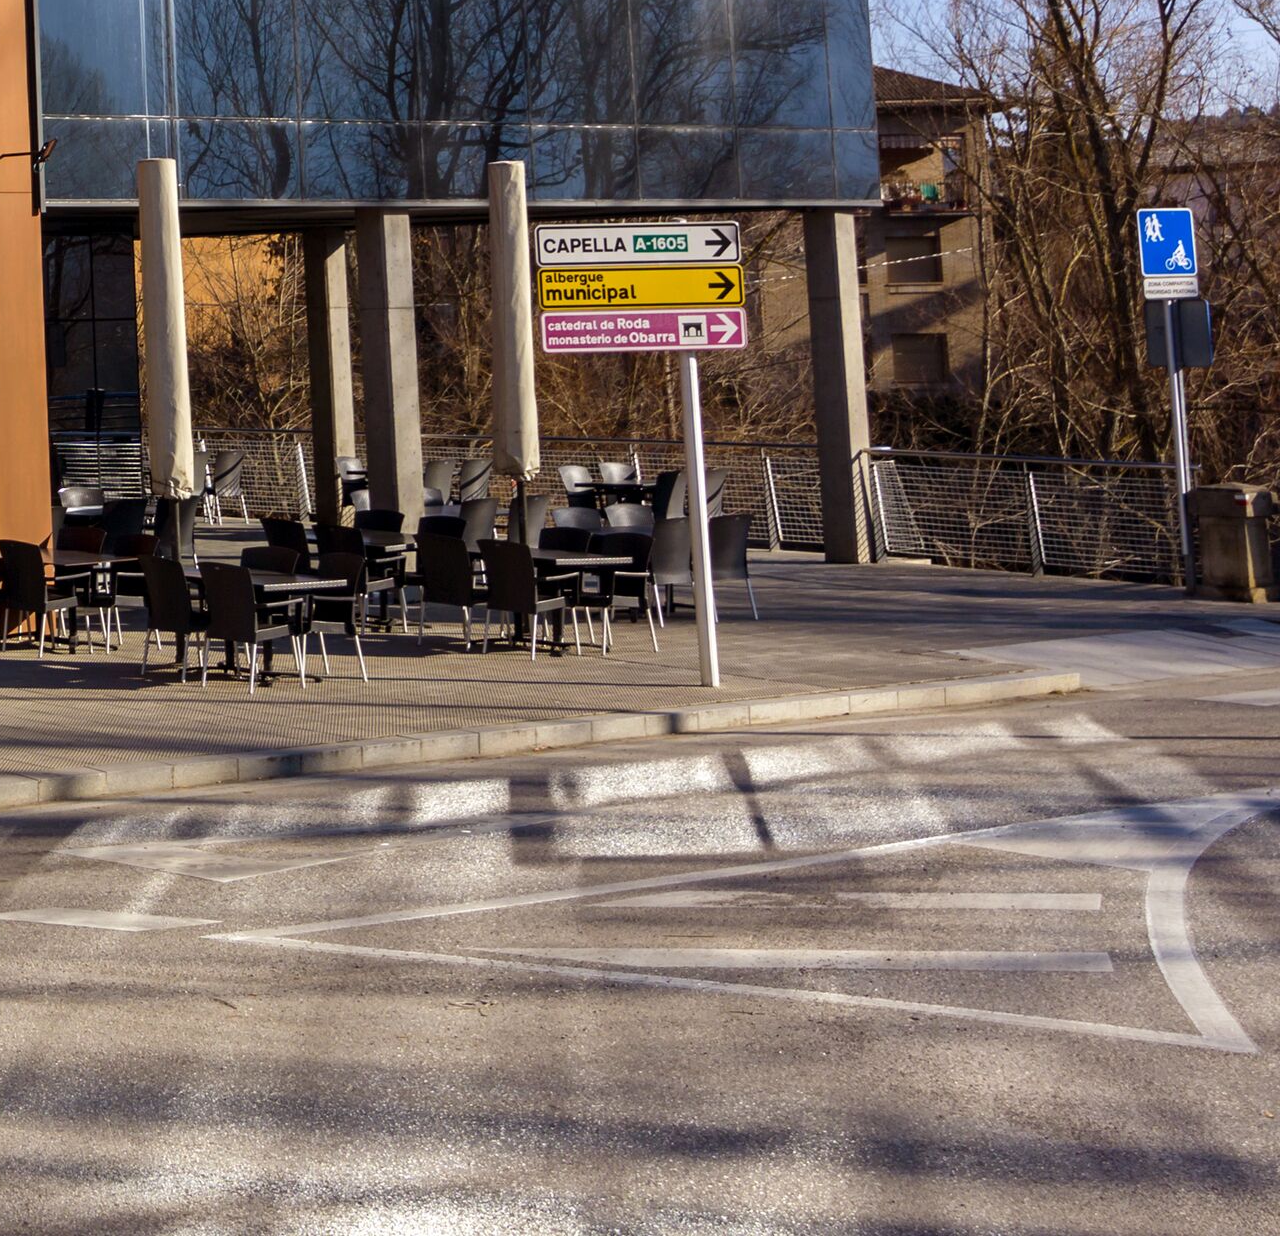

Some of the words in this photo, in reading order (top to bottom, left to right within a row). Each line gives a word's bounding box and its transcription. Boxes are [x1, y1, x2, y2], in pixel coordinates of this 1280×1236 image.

[543, 237, 627, 254] CAPELLA
[635, 236, 686, 251] A-1605
[545, 272, 603, 285] albergue
[545, 285, 637, 303] municipal
[547, 318, 597, 331] catedral
[600, 318, 615, 329] de
[617, 317, 650, 329] Roda
[548, 334, 611, 346] monasterio
[614, 334, 628, 344] de
[629, 331, 676, 344] Obarra
